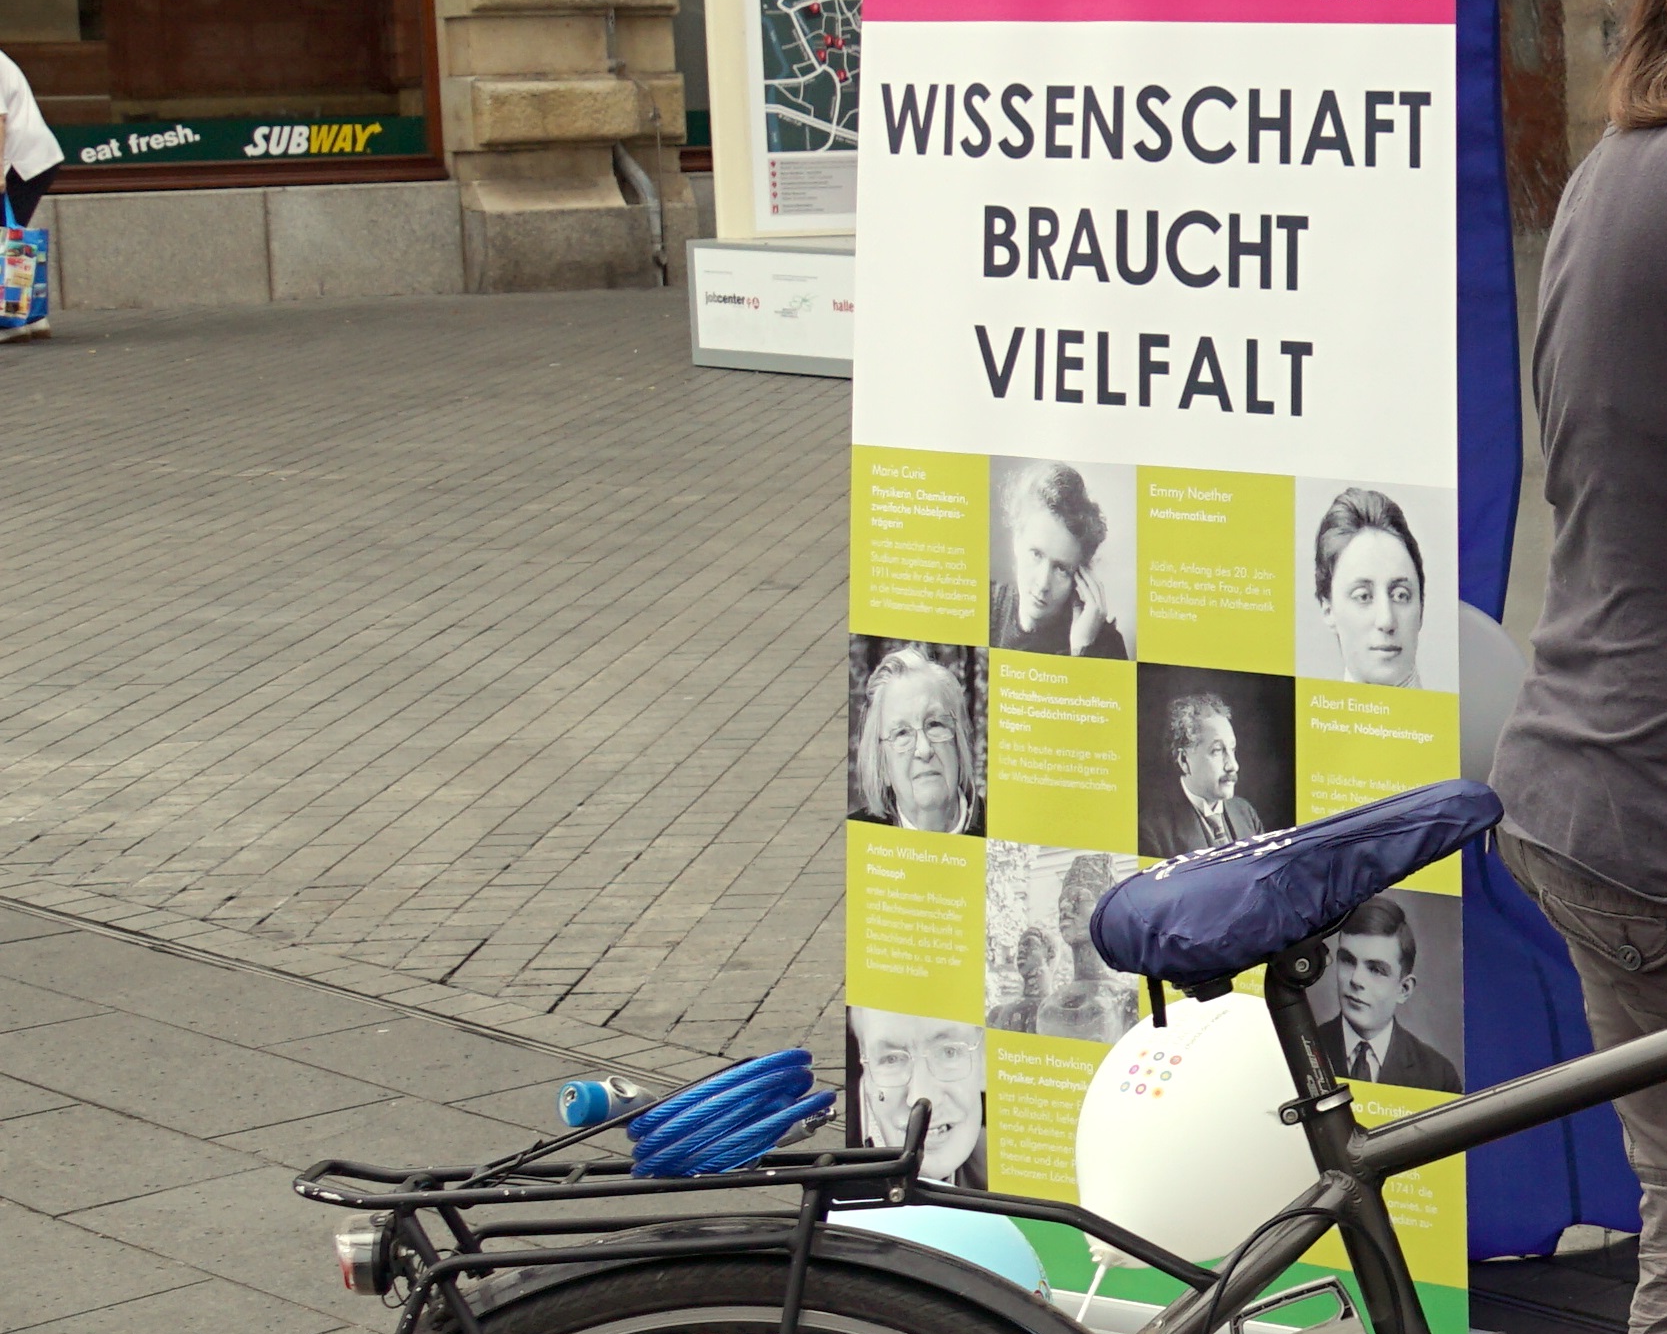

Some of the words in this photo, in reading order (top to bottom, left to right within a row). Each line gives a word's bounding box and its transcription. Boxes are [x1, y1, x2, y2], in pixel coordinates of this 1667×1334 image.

[881, 82, 1432, 169] WISSENSCHAFT
[81, 138, 122, 163] eat
[128, 124, 200, 154] fresh.
[243, 121, 383, 156] SUBWAY
[983, 205, 1309, 291] BRAUCHT
[705, 292, 745, 305] jobcenter
[974, 325, 1314, 417] VIELFALT
[872, 465, 899, 478] Marie
[901, 466, 926, 480] Curie
[1150, 484, 1184, 501] Emmy
[1188, 487, 1233, 502] Noether
[1150, 509, 1226, 523] Mathematikerin
[1000, 665, 1025, 679] Elinor
[1029, 669, 1068, 684] Ostrom
[1310, 695, 1344, 710] Albert
[1348, 698, 1390, 715] Einstein
[1311, 718, 1350, 733] Physiker,
[1354, 723, 1434, 743] Nobelpreisträger
[867, 843, 893, 857] Anton
[896, 847, 937, 863] Wilhelm
[941, 853, 967, 867] Amo
[998, 1048, 1041, 1065] Stephen
[1046, 1054, 1093, 1074] Hawking
[1038, 1076, 1088, 1091] Astrophysik
